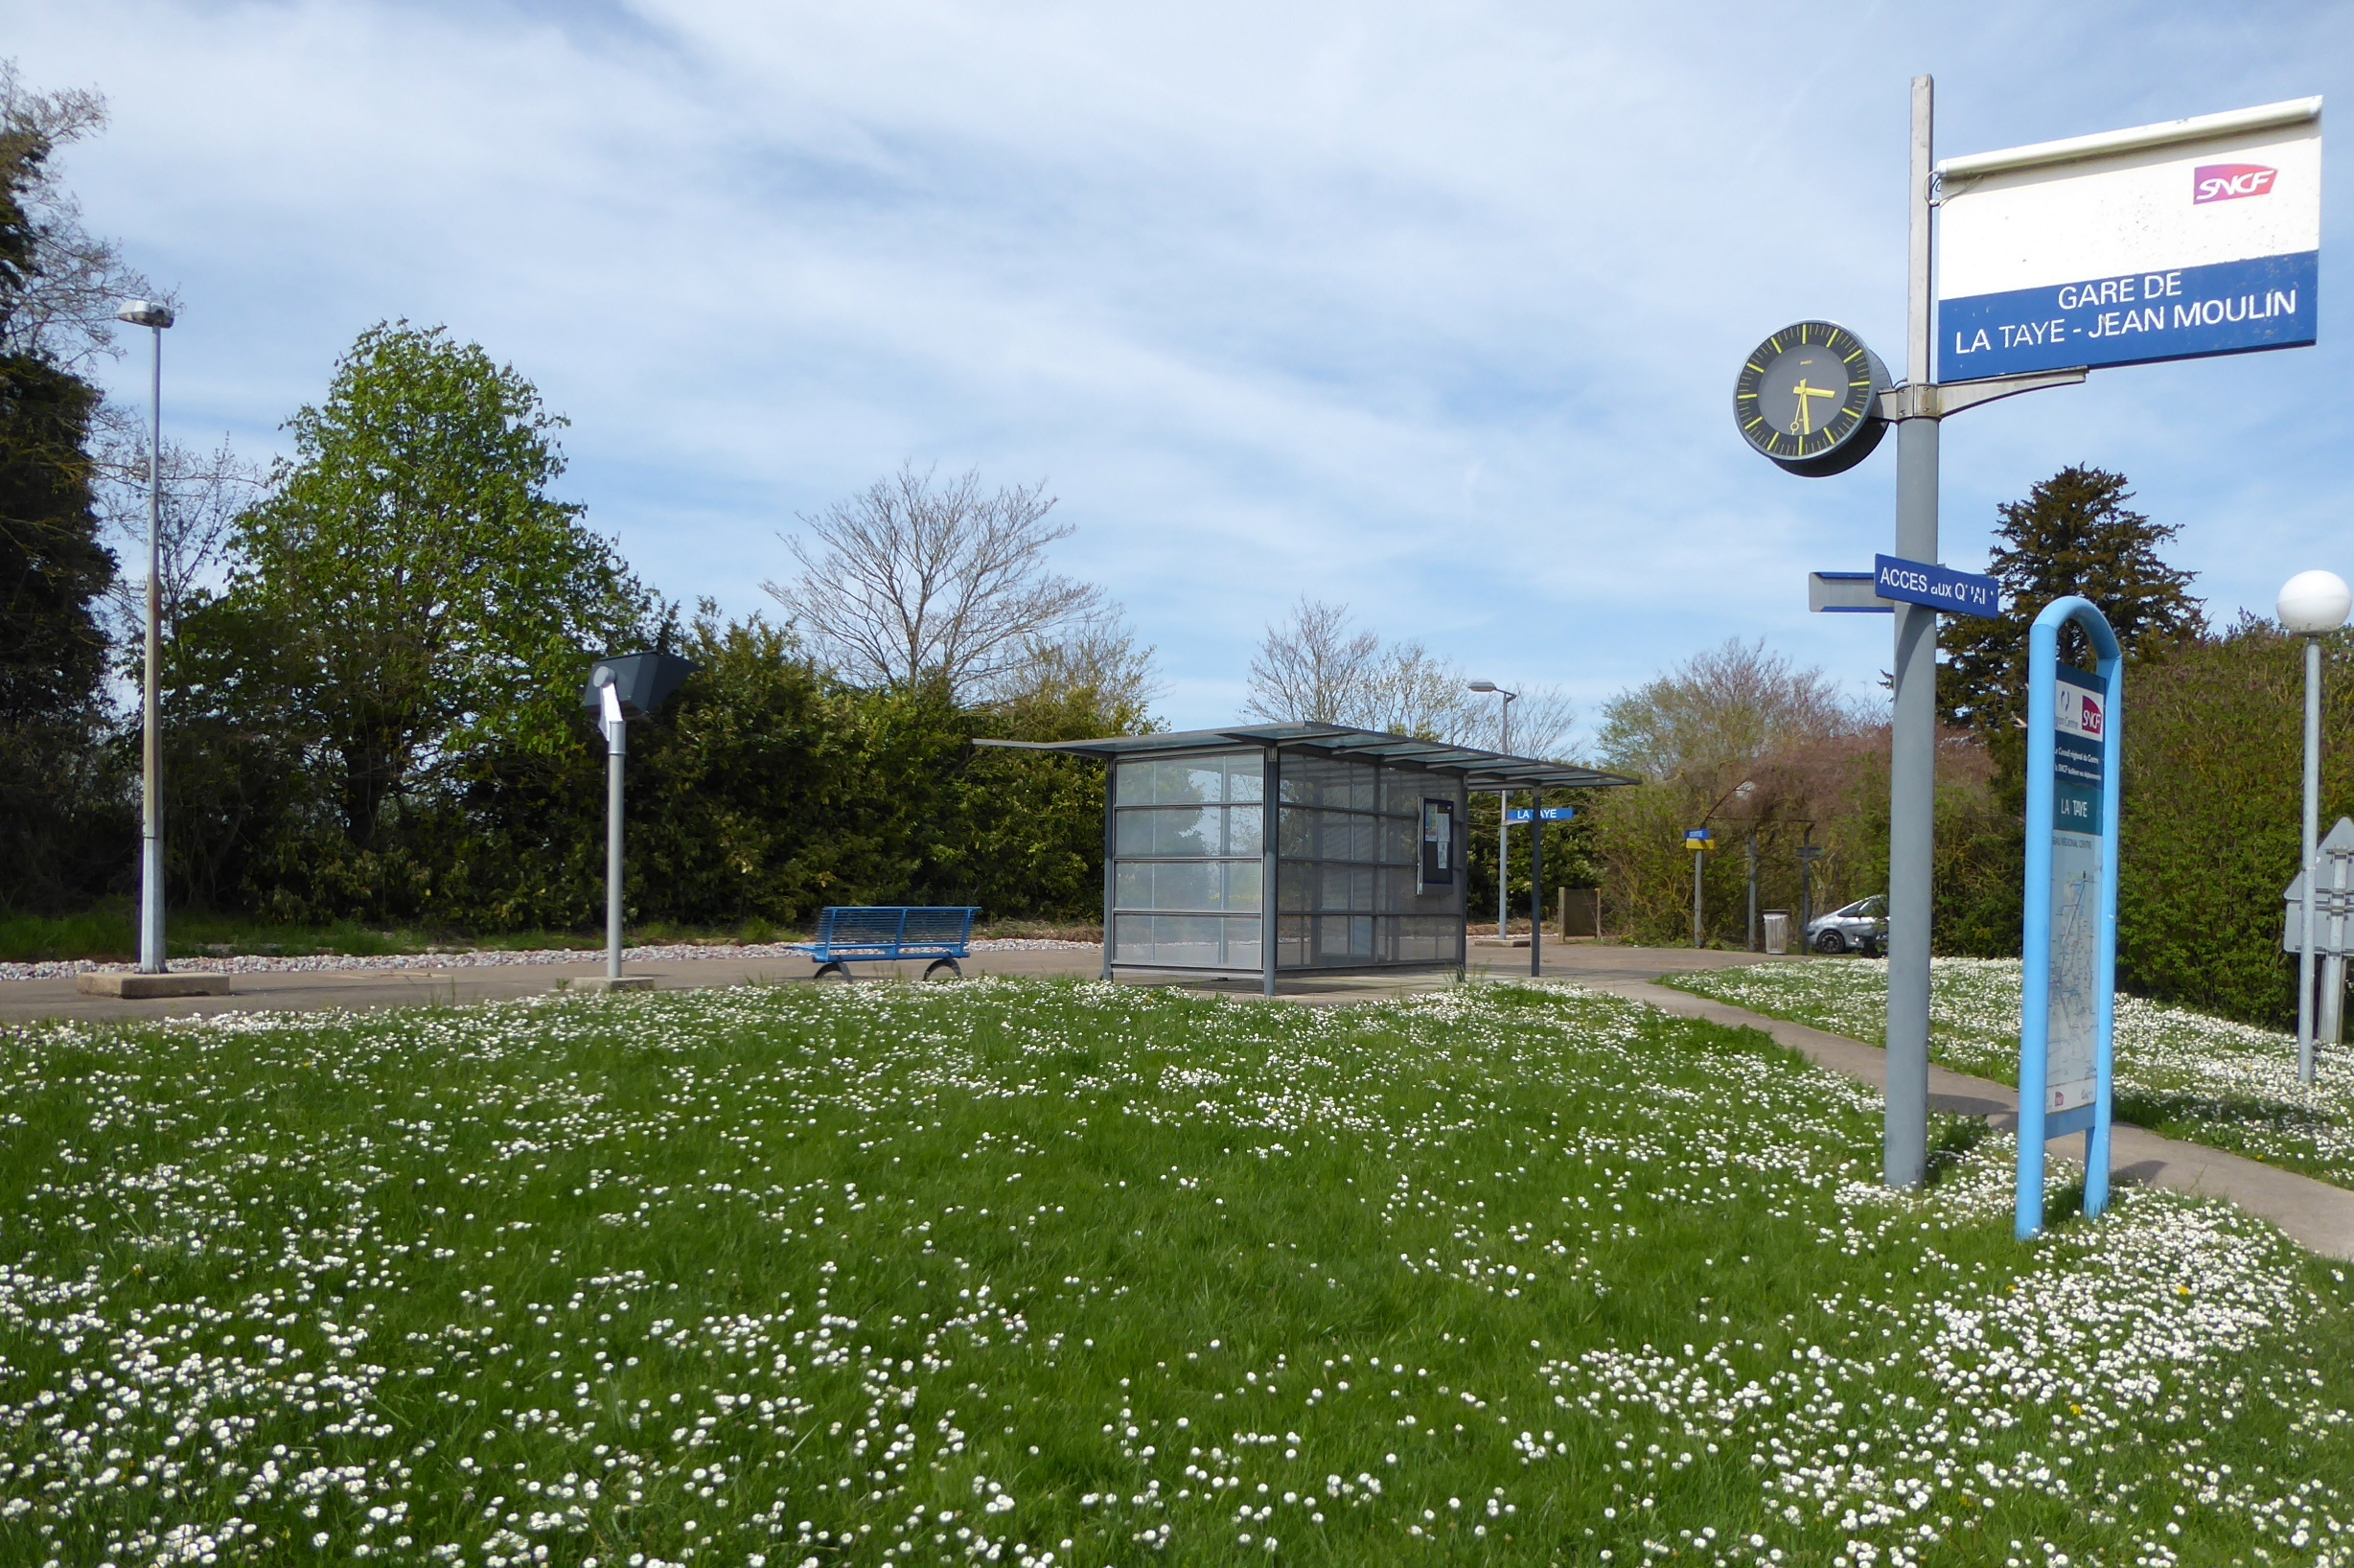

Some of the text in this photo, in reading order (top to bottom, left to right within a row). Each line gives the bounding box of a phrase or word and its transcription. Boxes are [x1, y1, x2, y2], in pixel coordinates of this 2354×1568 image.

[2196, 169, 2275, 200] SNCF
[2058, 271, 2182, 311] GARE DE
[1955, 329, 1991, 355] LA
[1998, 318, 2066, 348] TAYE
[2088, 306, 2164, 339] JEAN
[2173, 289, 2297, 328] MOULIN
[1880, 566, 1927, 592] ACCES
[1930, 582, 1952, 598] aux
[2082, 709, 2102, 729] SNCF
[1517, 808, 1557, 819] LA AYE
[2061, 798, 2088, 818] LA TAYE
